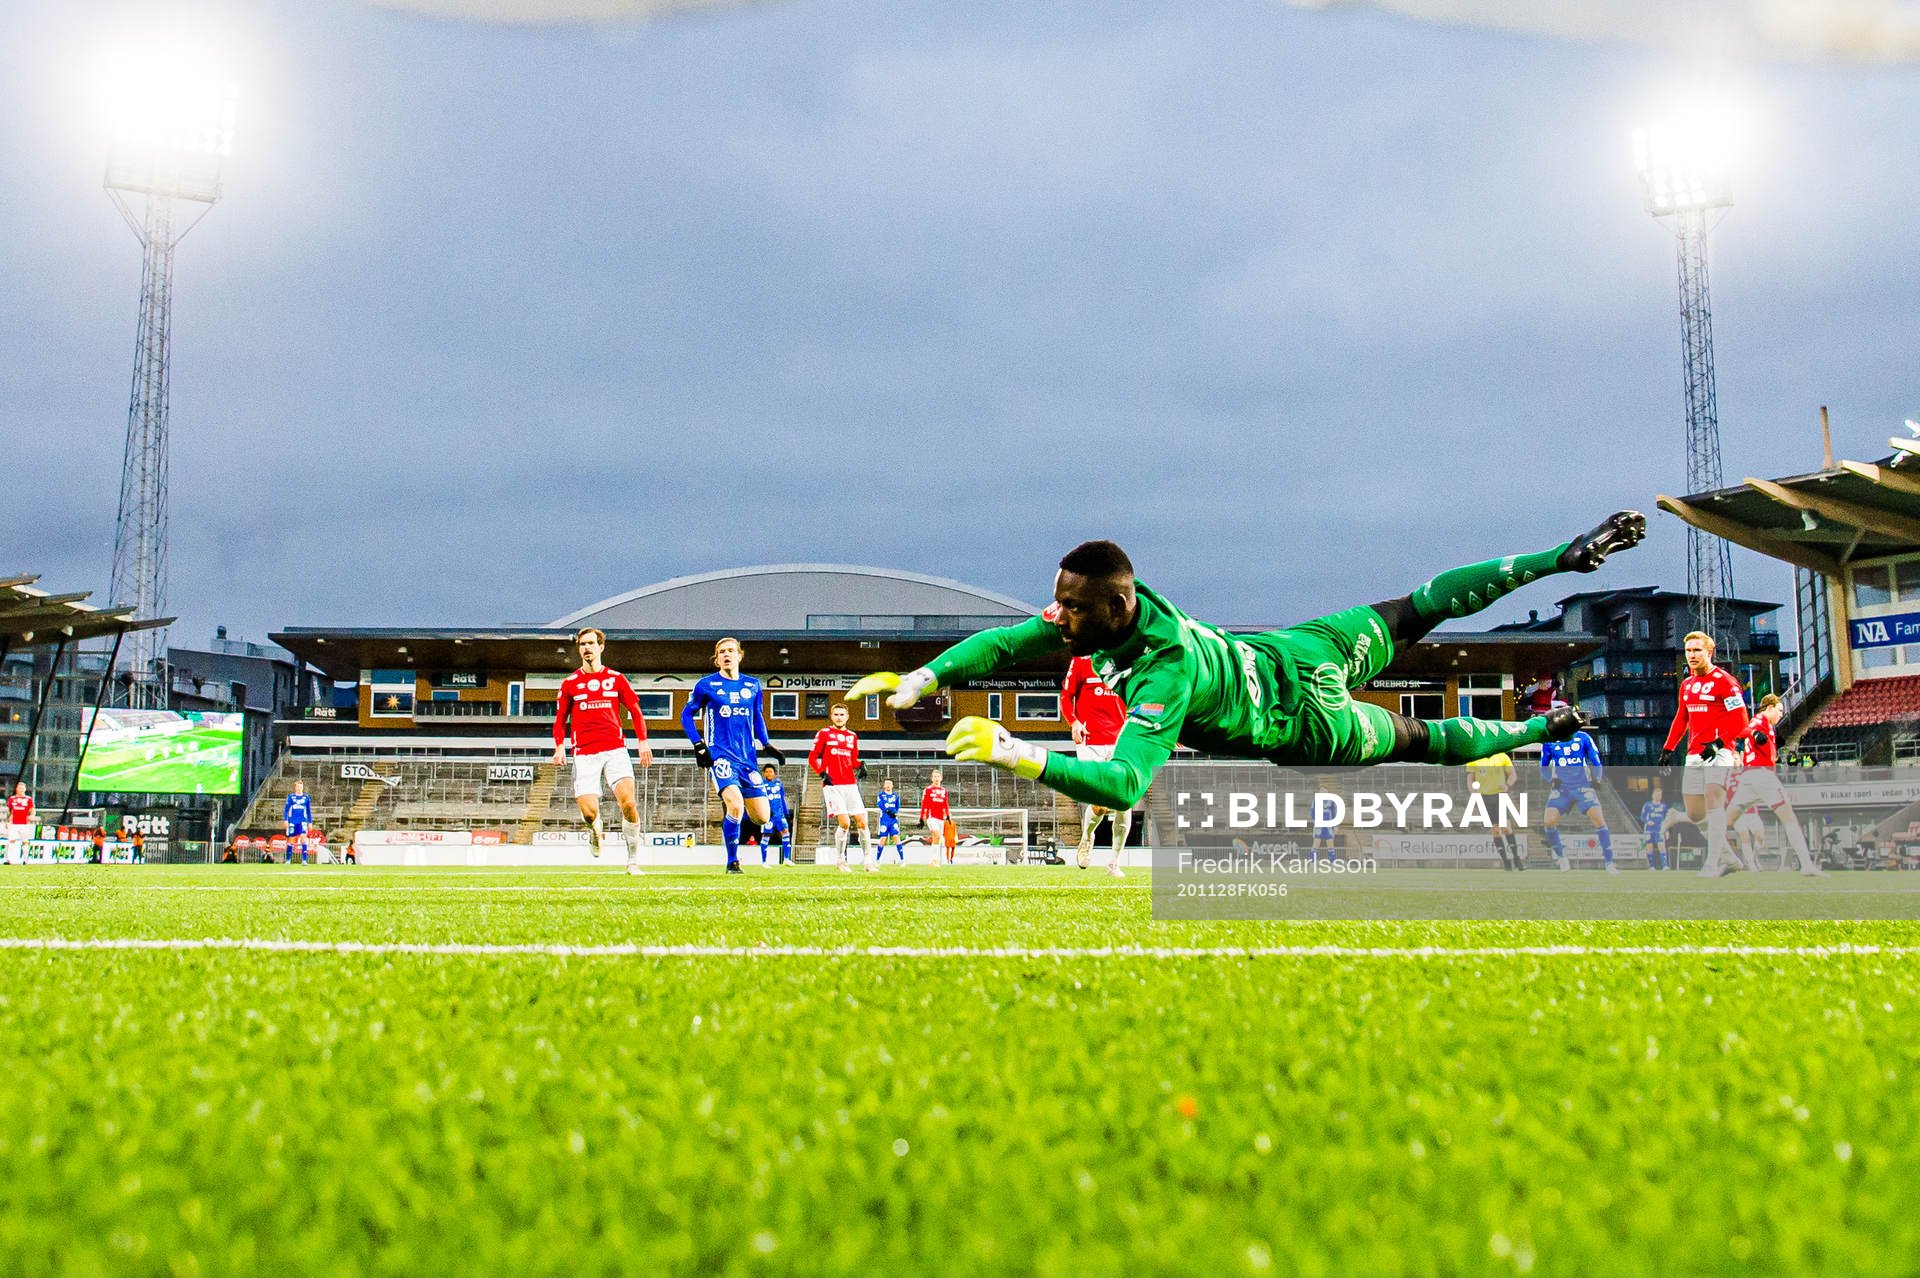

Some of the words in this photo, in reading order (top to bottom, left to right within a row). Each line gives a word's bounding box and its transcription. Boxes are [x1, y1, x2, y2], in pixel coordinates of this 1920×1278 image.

[1856, 621, 1890, 643] NA
[452, 673, 477, 683] Rätt
[786, 676, 836, 688] polyterm
[1018, 679, 1056, 689] Sparbank
[314, 707, 337, 717] Rätt
[732, 707, 750, 716] SCA
[489, 767, 532, 778] HJÄRTA
[1854, 790, 1872, 799] sport
[1882, 789, 1903, 797] sedan
[122, 814, 169, 835] Rätt
[538, 832, 566, 841] ICON
[1252, 841, 1298, 855] Accesit
[1400, 840, 1525, 855] Reklamproffen
